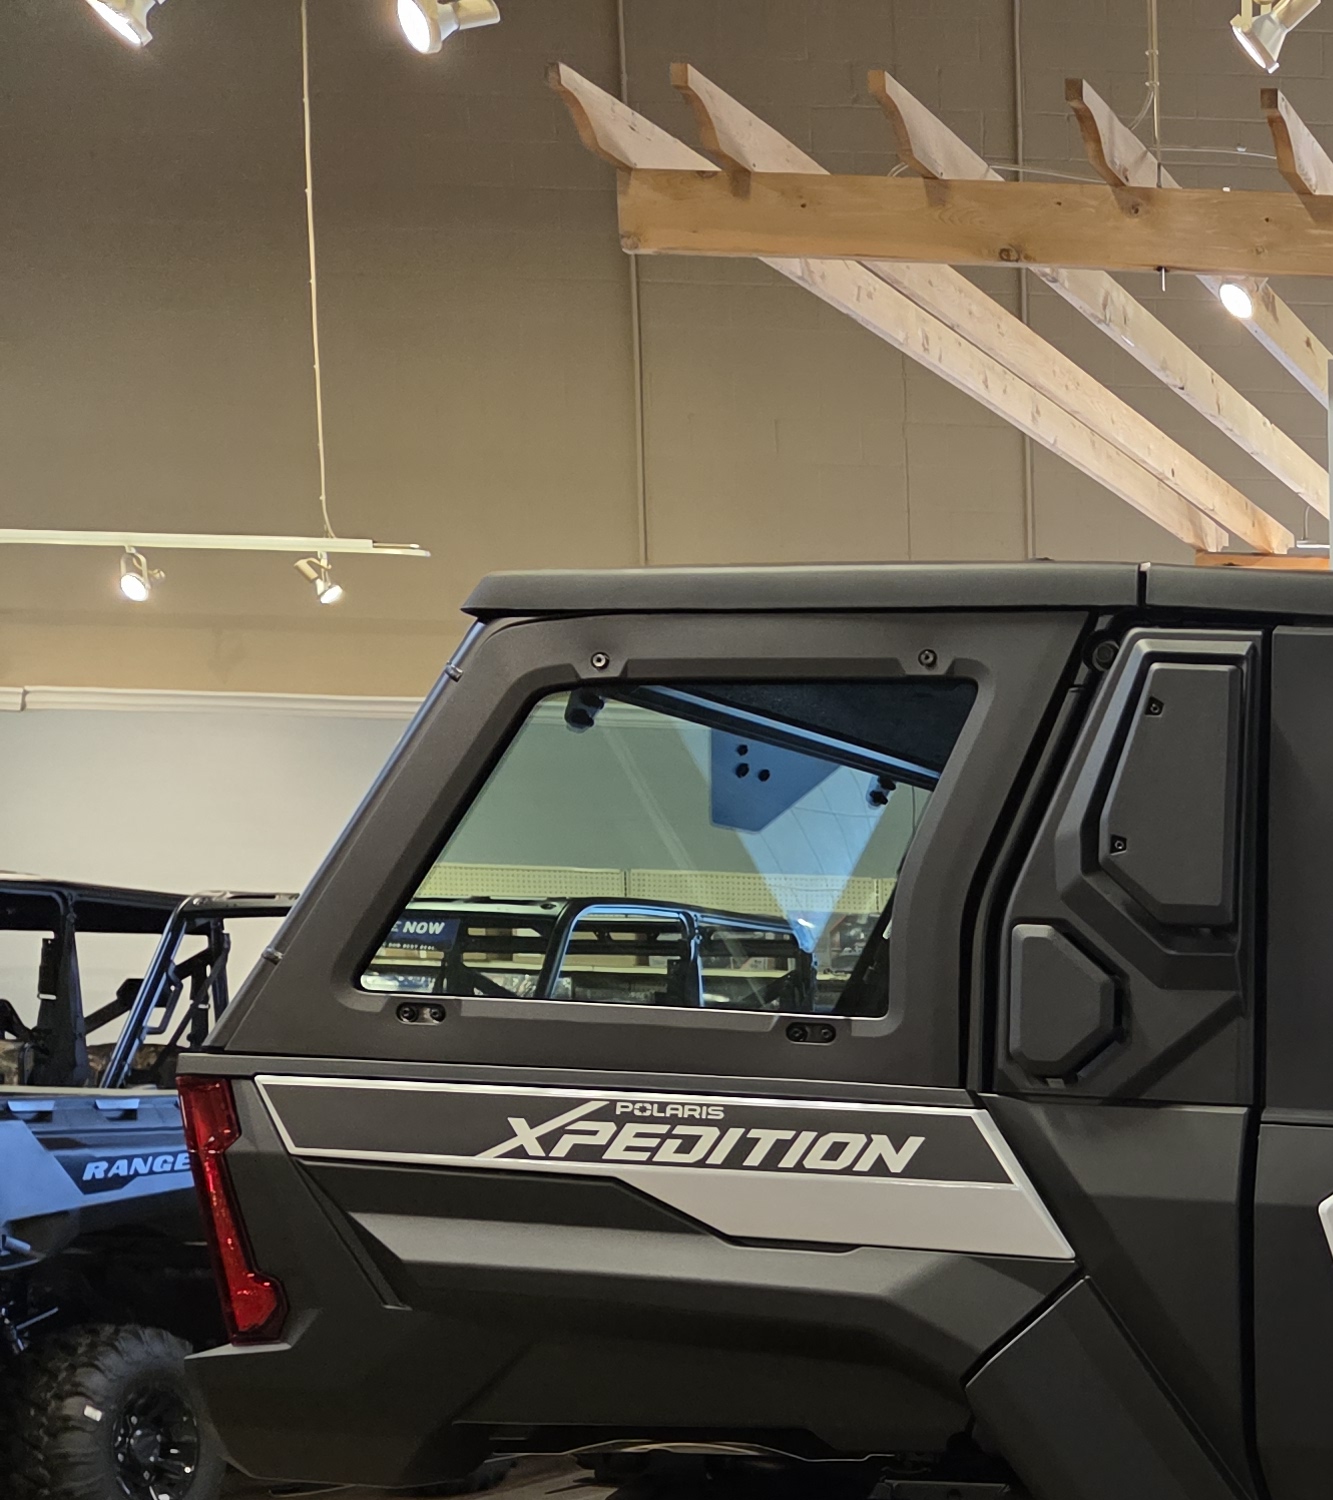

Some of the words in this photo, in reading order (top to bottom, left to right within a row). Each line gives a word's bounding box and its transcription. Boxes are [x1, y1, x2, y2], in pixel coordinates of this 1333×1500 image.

[402, 921, 446, 935] NOW
[615, 1102, 725, 1120] POLARIS
[475, 1100, 926, 1173] XPEDITION
